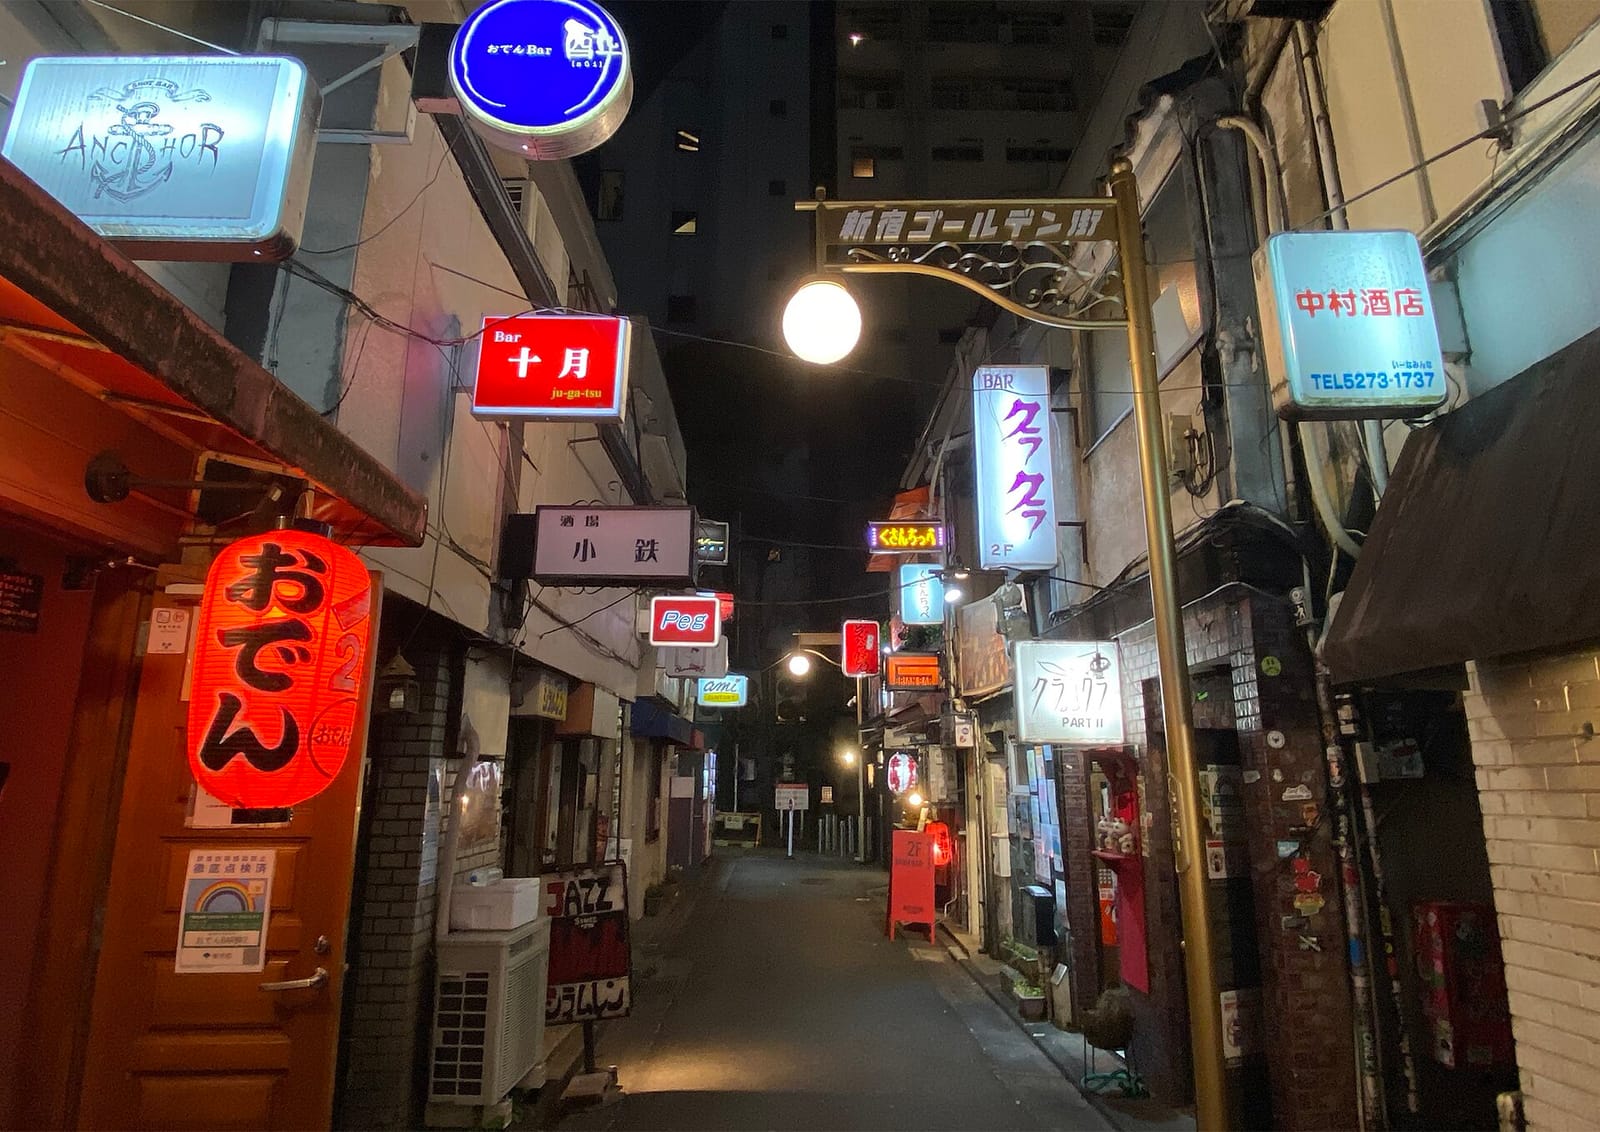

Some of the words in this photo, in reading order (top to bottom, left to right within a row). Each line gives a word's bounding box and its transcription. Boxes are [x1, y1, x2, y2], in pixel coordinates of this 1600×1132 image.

[60, 121, 224, 178] ANCHOR
[839, 207, 1103, 241] 新宿ゴールデン街
[1296, 288, 1425, 318] 中村酒店
[494, 331, 521, 342] Bar
[507, 346, 590, 379] 十月
[982, 373, 1014, 389] BAR
[551, 387, 602, 400] ju-ga-tsu
[560, 515, 599, 528] 酒場
[572, 538, 660, 563] 小鉄
[991, 544, 1014, 556] 2F
[660, 611, 709, 631] Peg
[199, 542, 328, 772] おでん
[703, 680, 738, 693] ami
[1062, 717, 1091, 728] PART
[907, 840, 922, 857] 2F
[547, 878, 613, 917] JAZZ
